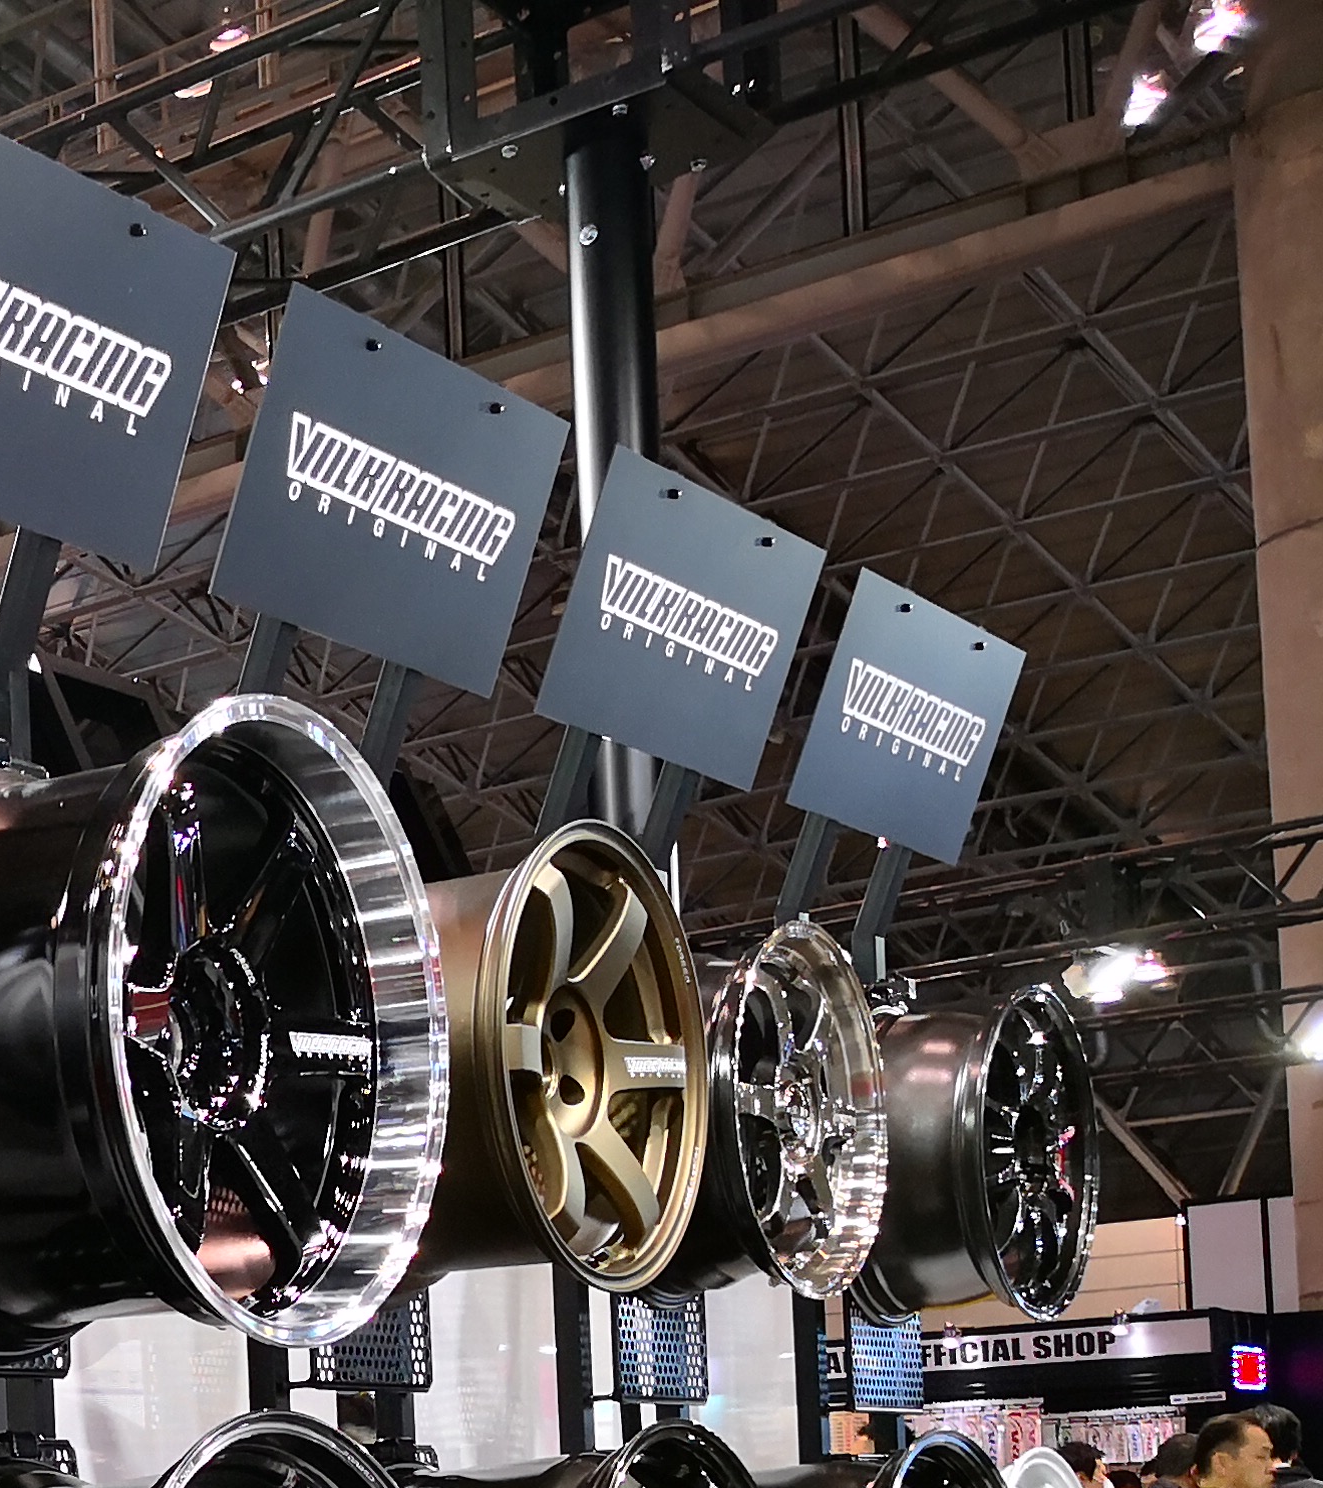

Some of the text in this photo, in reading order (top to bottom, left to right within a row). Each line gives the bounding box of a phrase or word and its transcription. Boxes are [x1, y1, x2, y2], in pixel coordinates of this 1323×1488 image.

[287, 411, 515, 566] VOLK RACING
[289, 483, 485, 581] ORIGINAL
[601, 554, 778, 677] VOLK RACING
[601, 613, 752, 691] ORIGINAL
[841, 716, 961, 782] ORIGINAL
[843, 658, 985, 767] VOLK RACING
[921, 1331, 1116, 1367] FFICIAL SHOP
